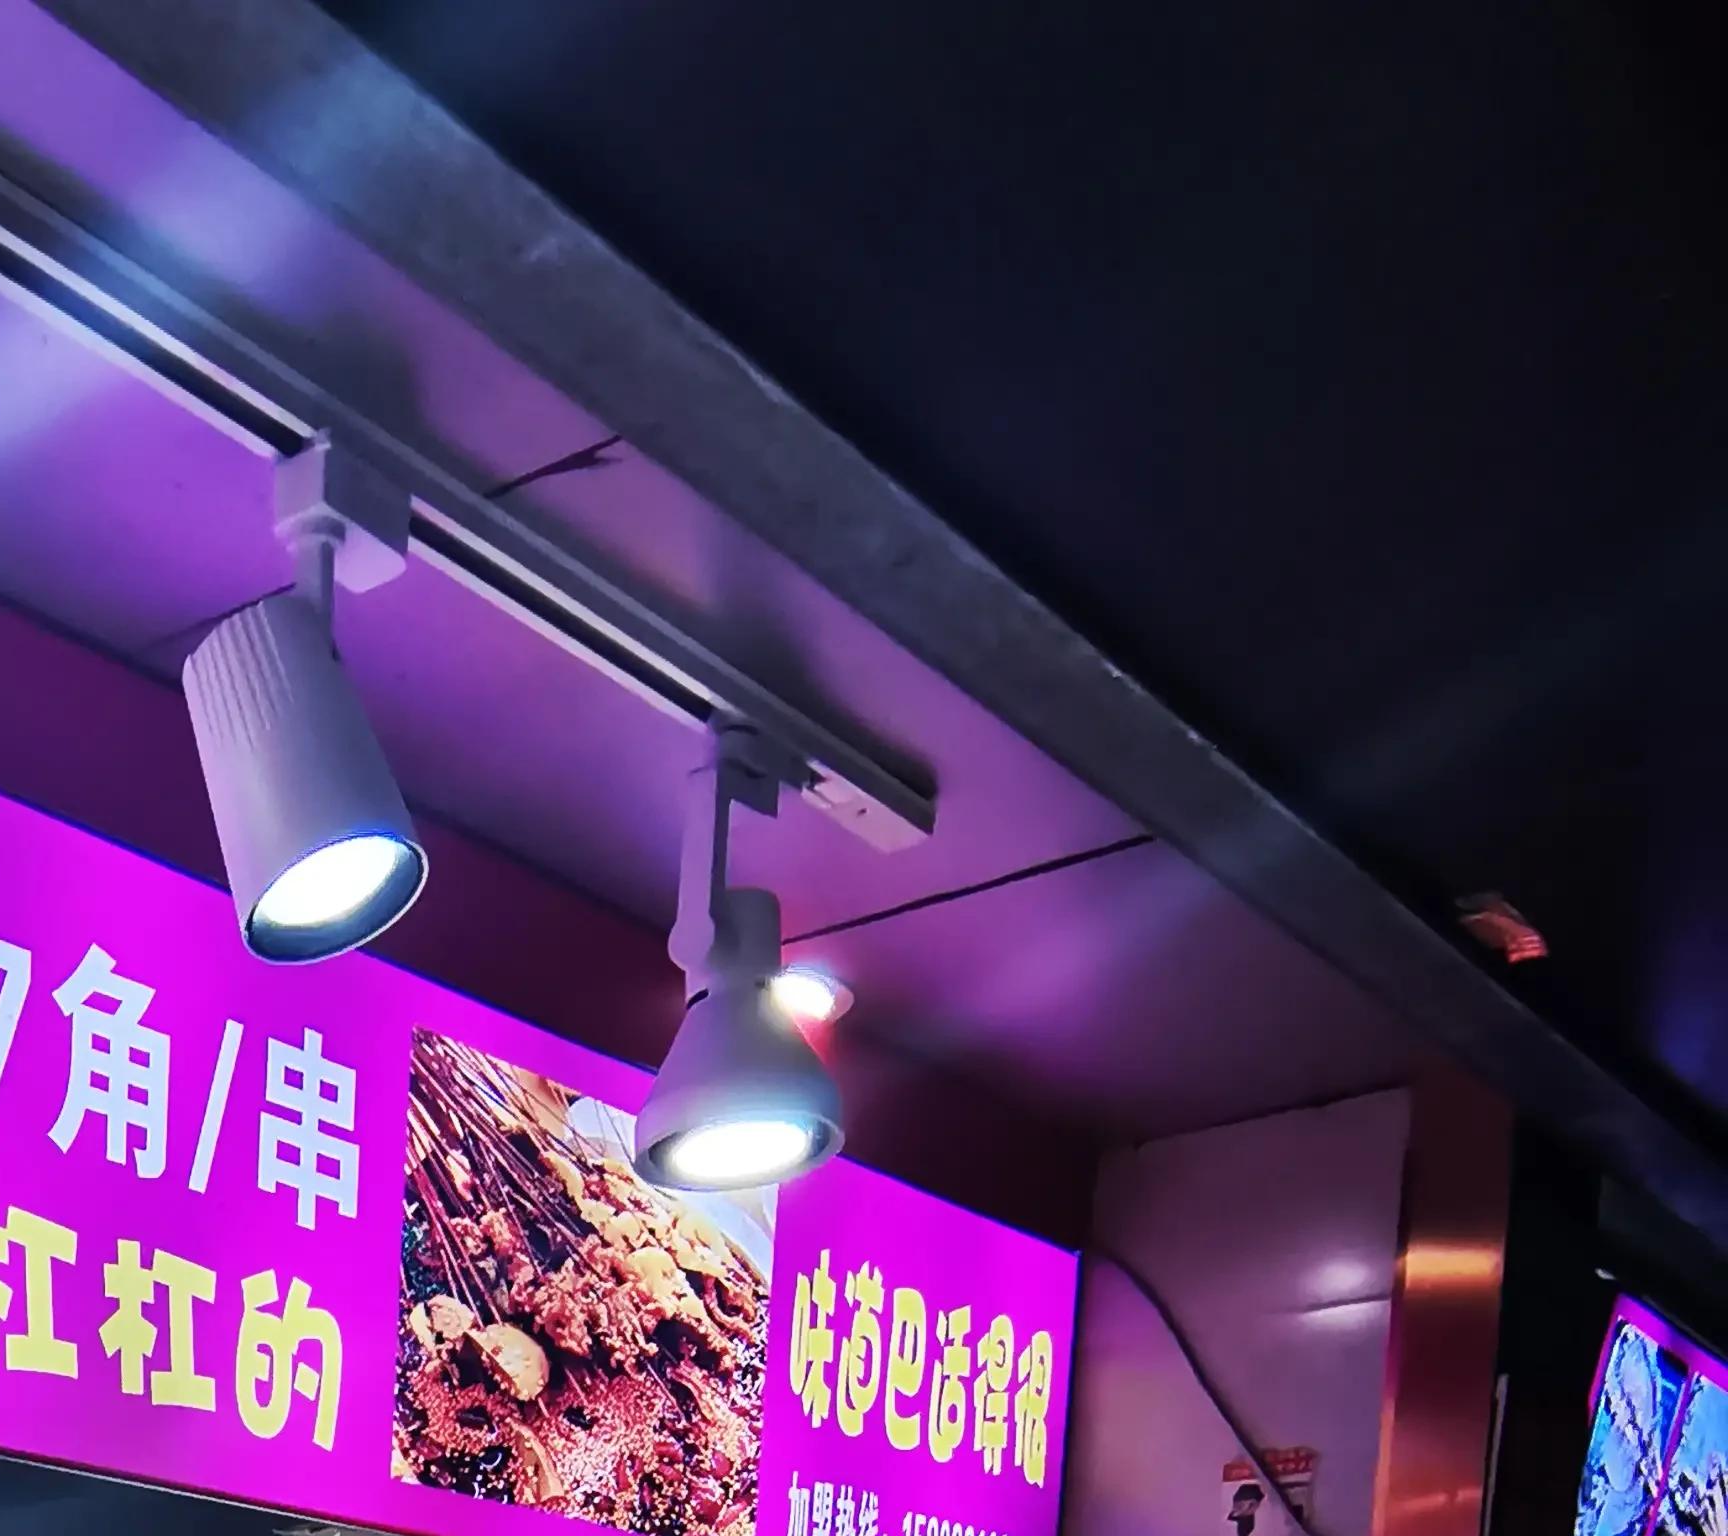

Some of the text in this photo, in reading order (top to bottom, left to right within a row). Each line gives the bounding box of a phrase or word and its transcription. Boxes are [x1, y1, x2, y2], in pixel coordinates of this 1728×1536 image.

[789, 1248, 1053, 1488] 味道巴适得很
